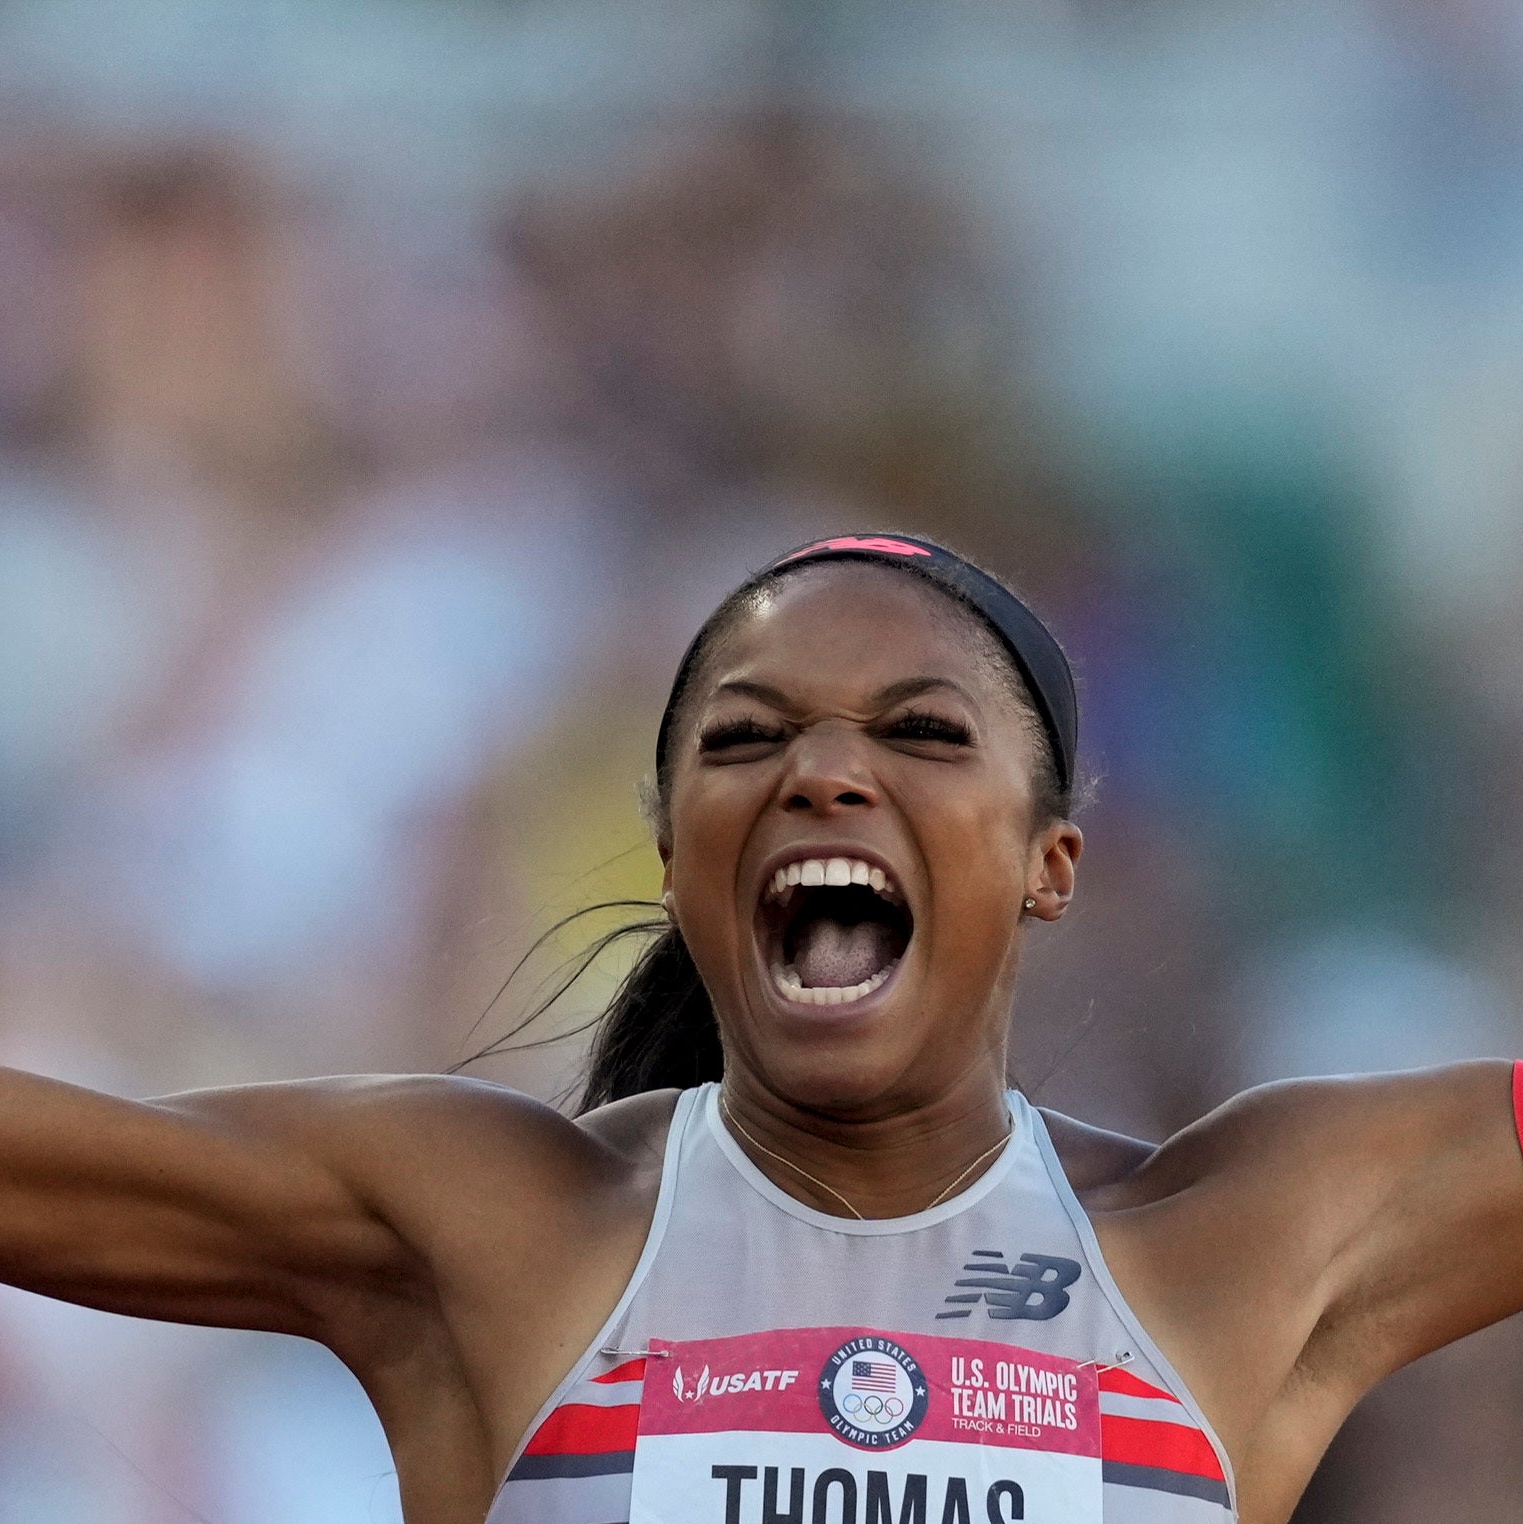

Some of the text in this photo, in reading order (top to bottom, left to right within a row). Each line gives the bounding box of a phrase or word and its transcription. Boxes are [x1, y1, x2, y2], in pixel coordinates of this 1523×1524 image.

[831, 1338, 917, 1372] UNITED STATES
[709, 1370, 799, 1396] USATF
[951, 1356, 1078, 1402] U.S. OLYMPIC
[950, 1387, 1078, 1431] TEAM TRIALS
[830, 1414, 915, 1445] OLYMPIC TEAM
[951, 1417, 1041, 1437] TRACK & FIELD
